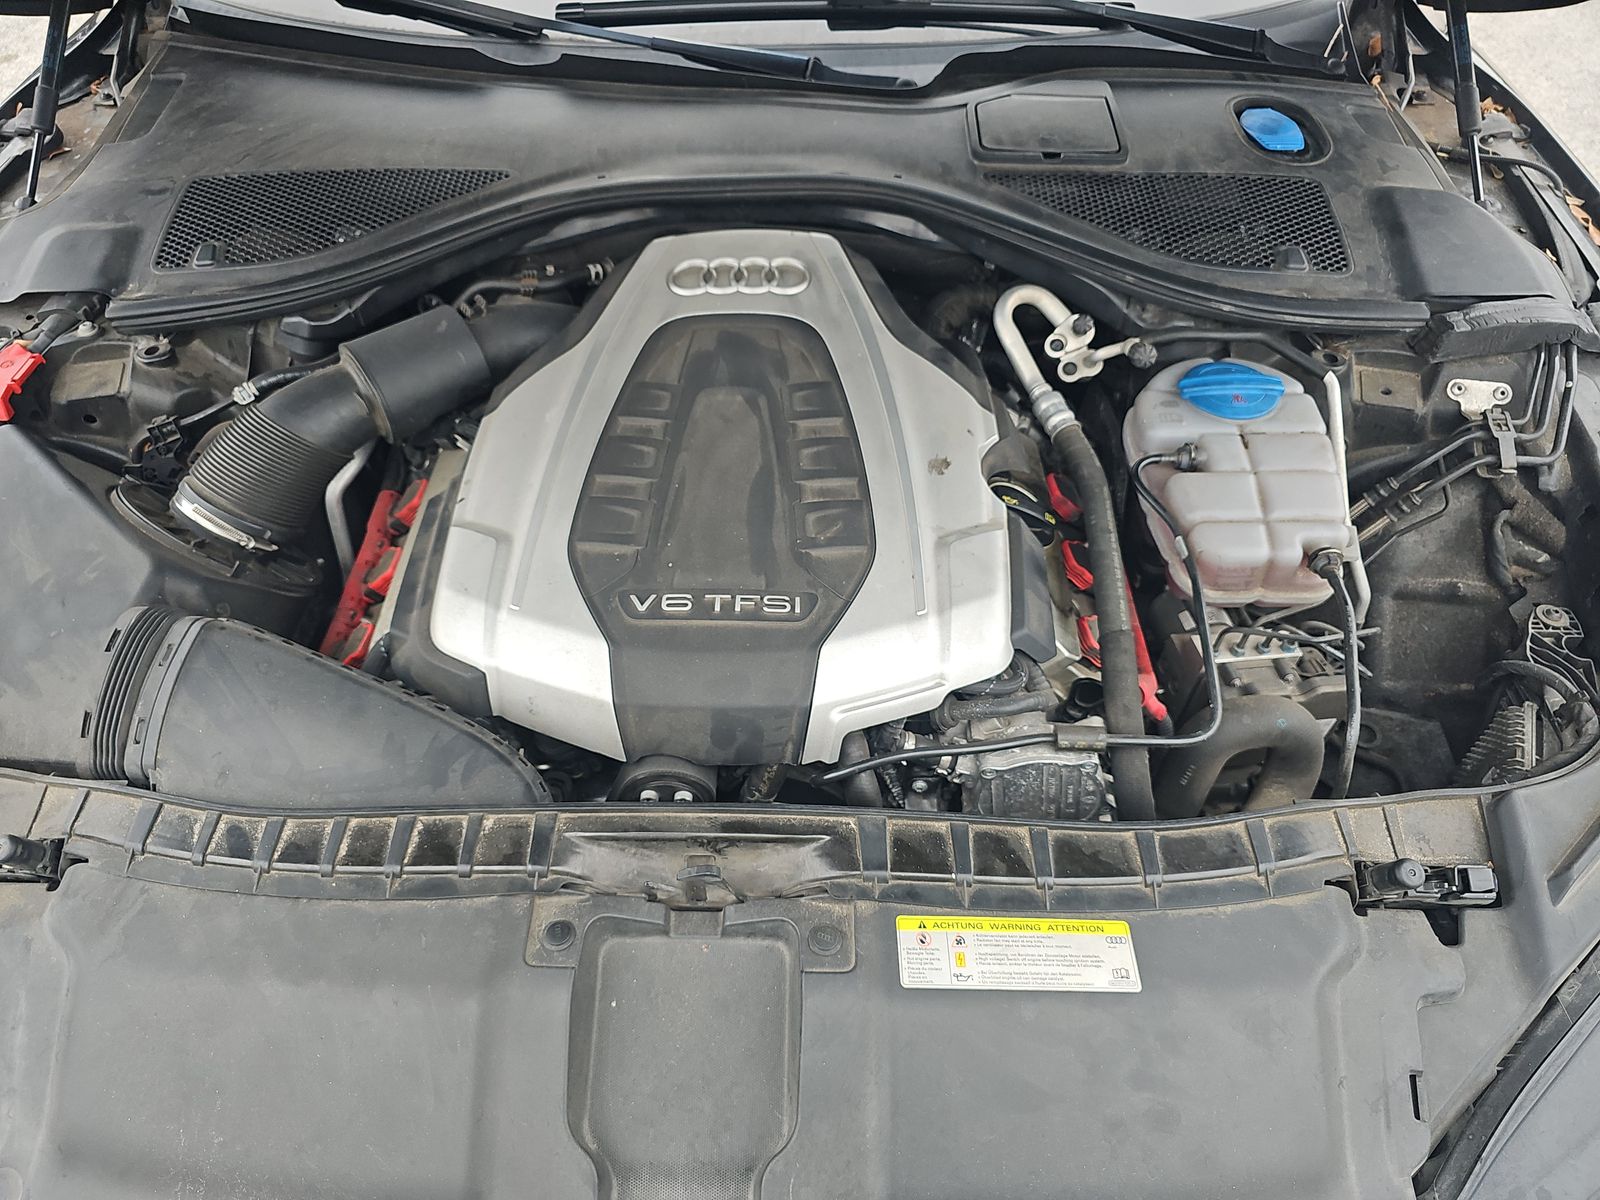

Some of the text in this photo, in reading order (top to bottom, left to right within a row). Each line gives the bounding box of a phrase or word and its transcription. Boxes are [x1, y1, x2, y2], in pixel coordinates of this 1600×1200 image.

[630, 593, 801, 614] V6 TFSI
[932, 921, 1104, 932] ACHTUNG WARNING ATTENTION
